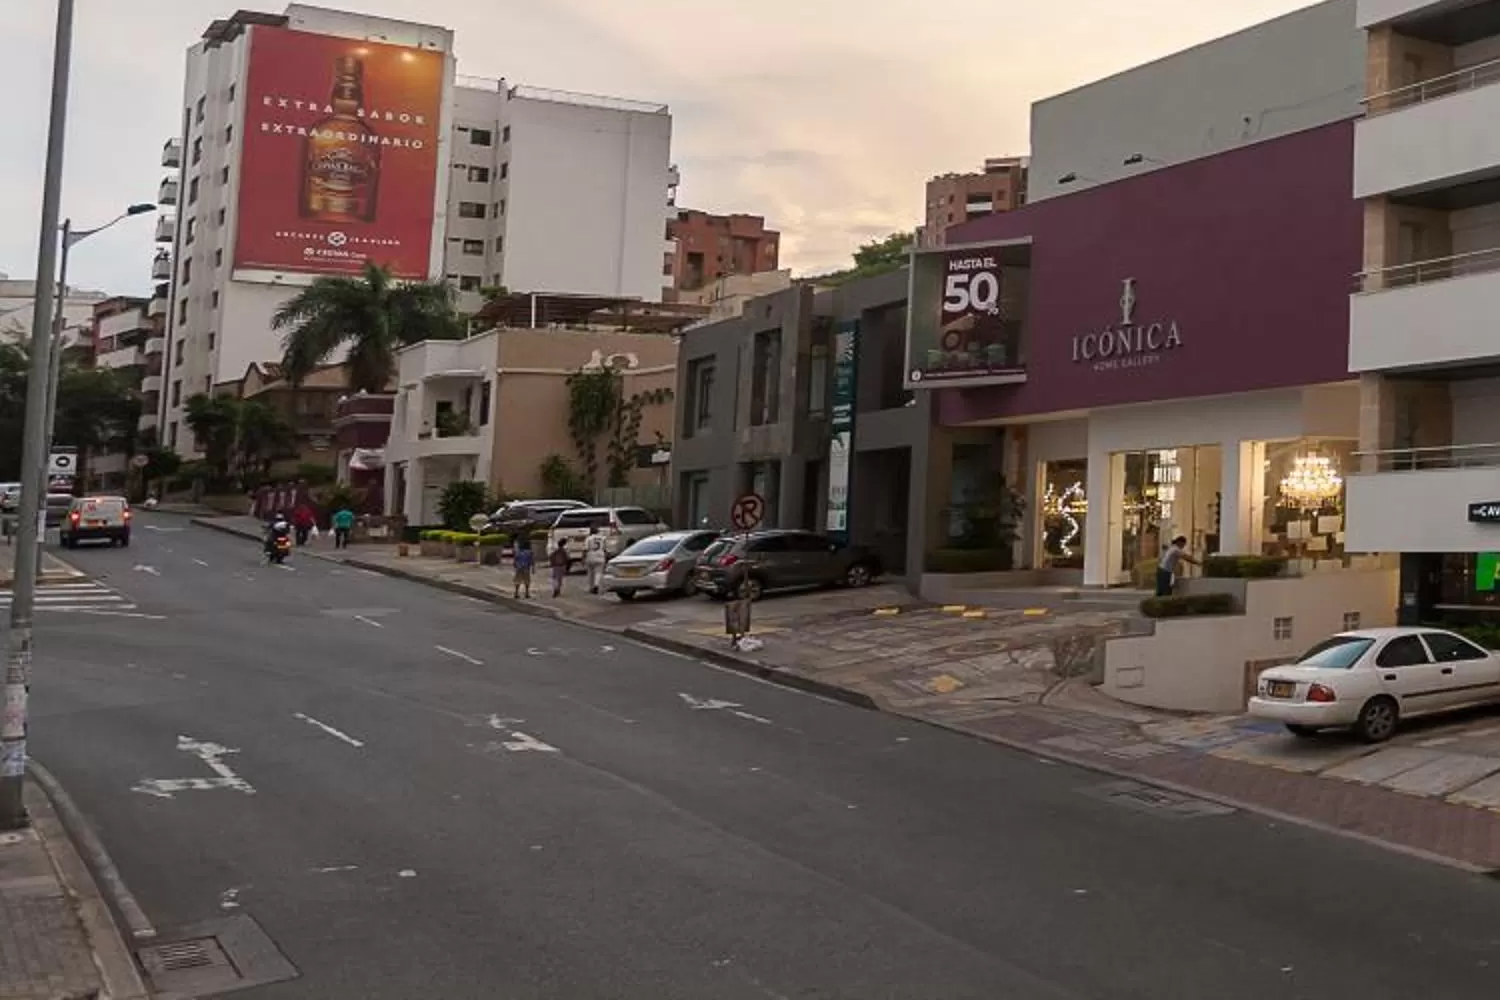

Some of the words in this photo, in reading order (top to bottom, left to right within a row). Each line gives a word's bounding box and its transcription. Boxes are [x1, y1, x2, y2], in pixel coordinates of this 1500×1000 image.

[263, 96, 333, 113] EXTRA
[357, 108, 425, 125] SABOR
[260, 122, 424, 149] EXTRAORDINARIO
[949, 258, 982, 271] HASTA
[983, 257, 997, 268] EL
[1071, 320, 1183, 361] ICÓNICA
